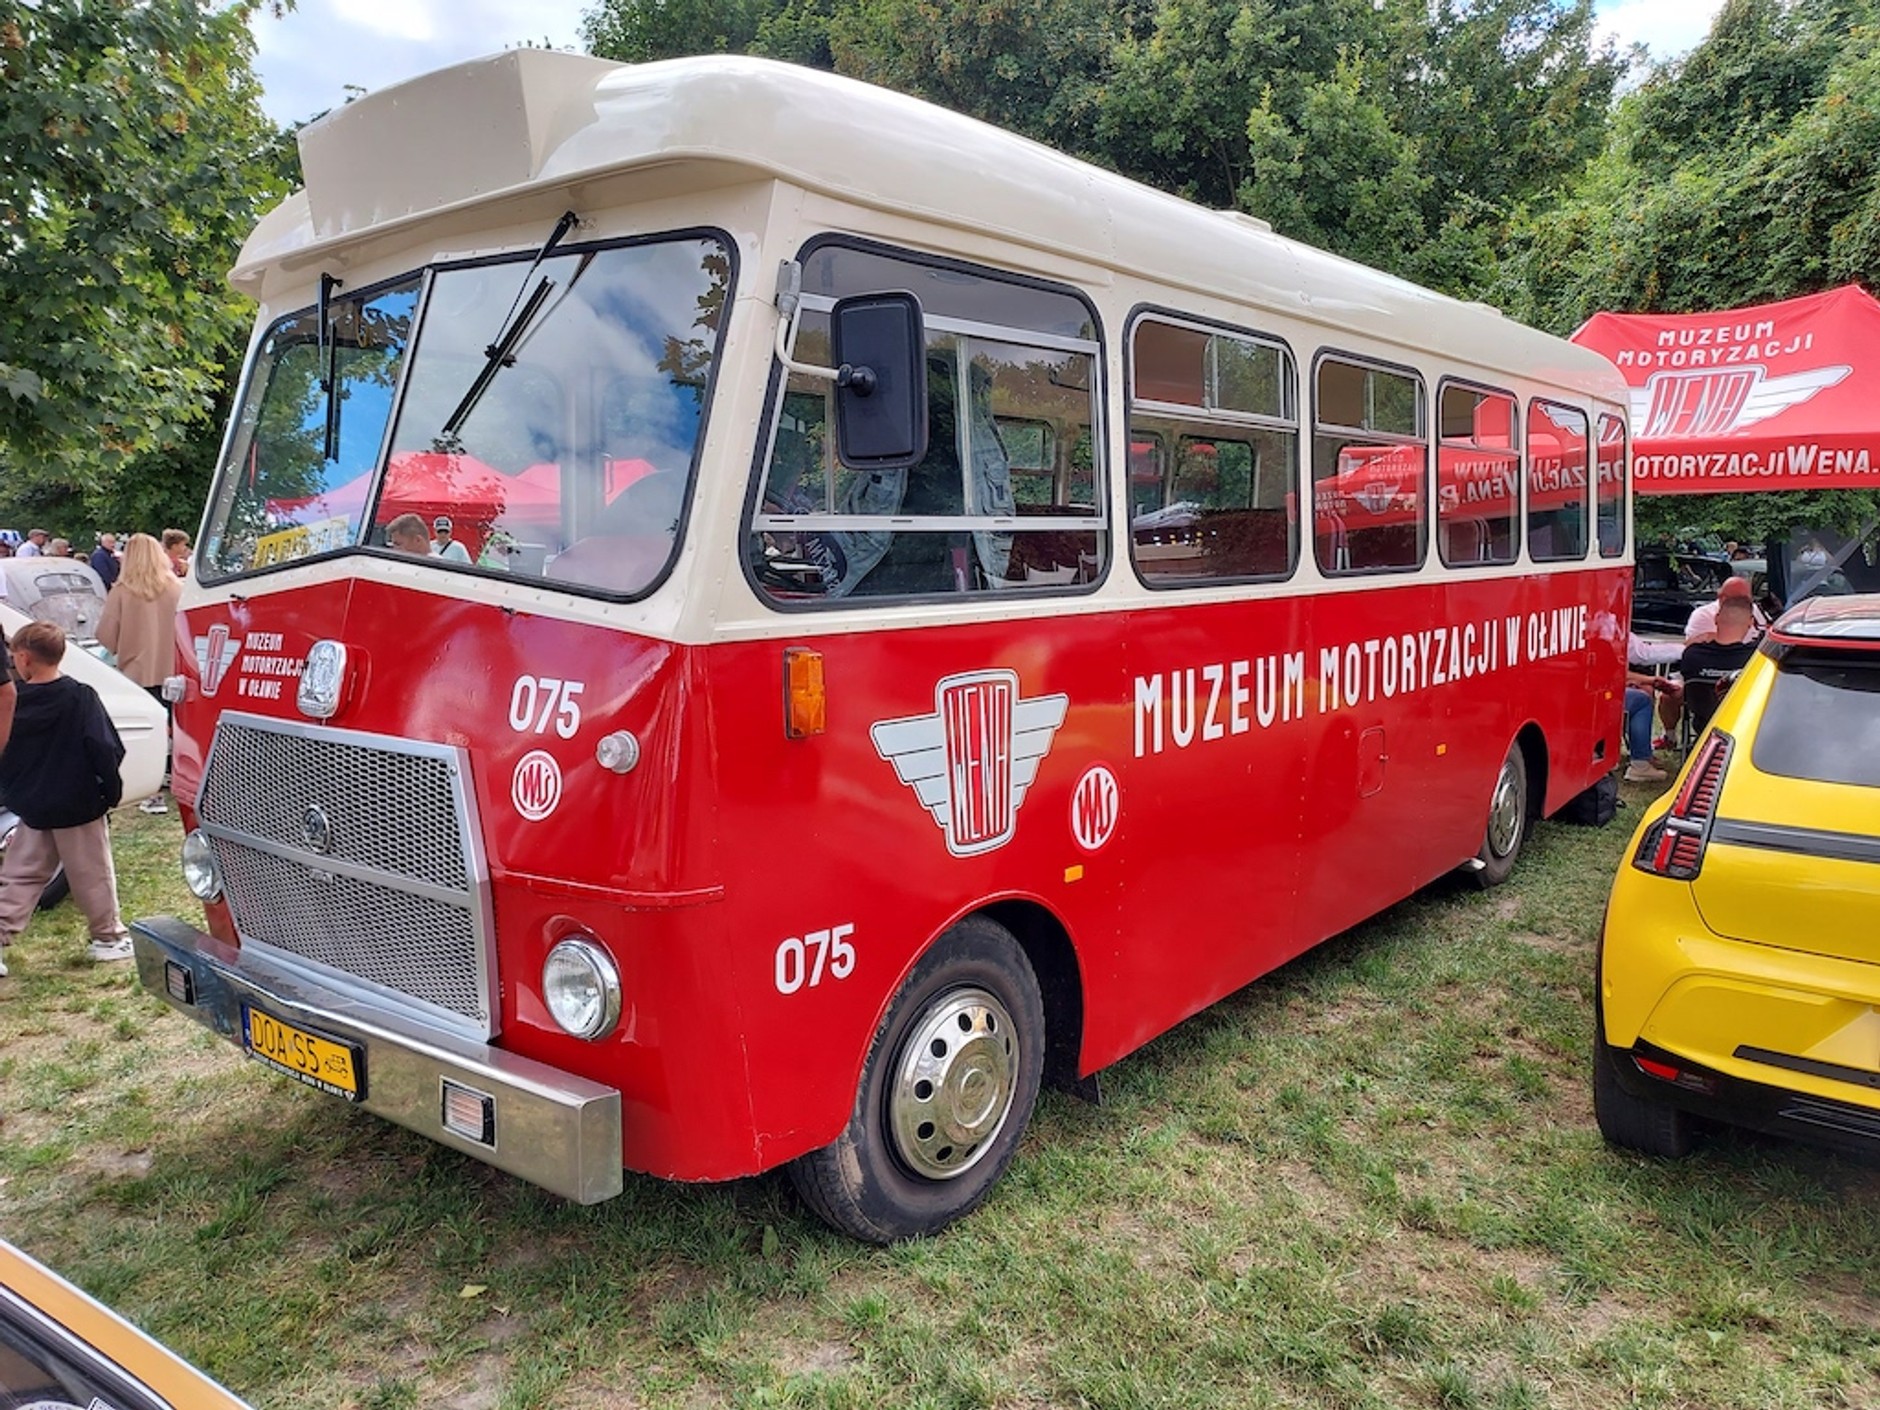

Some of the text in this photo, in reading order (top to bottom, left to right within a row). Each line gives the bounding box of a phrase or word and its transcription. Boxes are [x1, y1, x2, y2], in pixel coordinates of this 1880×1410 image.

[1616, 333, 1814, 367] MOTORYZACJI
[1657, 320, 1775, 347] MUZEUM
[244, 632, 284, 651] MUZEUM
[509, 675, 585, 739] 075
[1133, 605, 1588, 759] MUZEUM MOTORYZACJI W OŁAWIE
[774, 923, 856, 995] 075
[252, 1013, 288, 1062] DOA
[293, 1033, 320, 1074] S5
